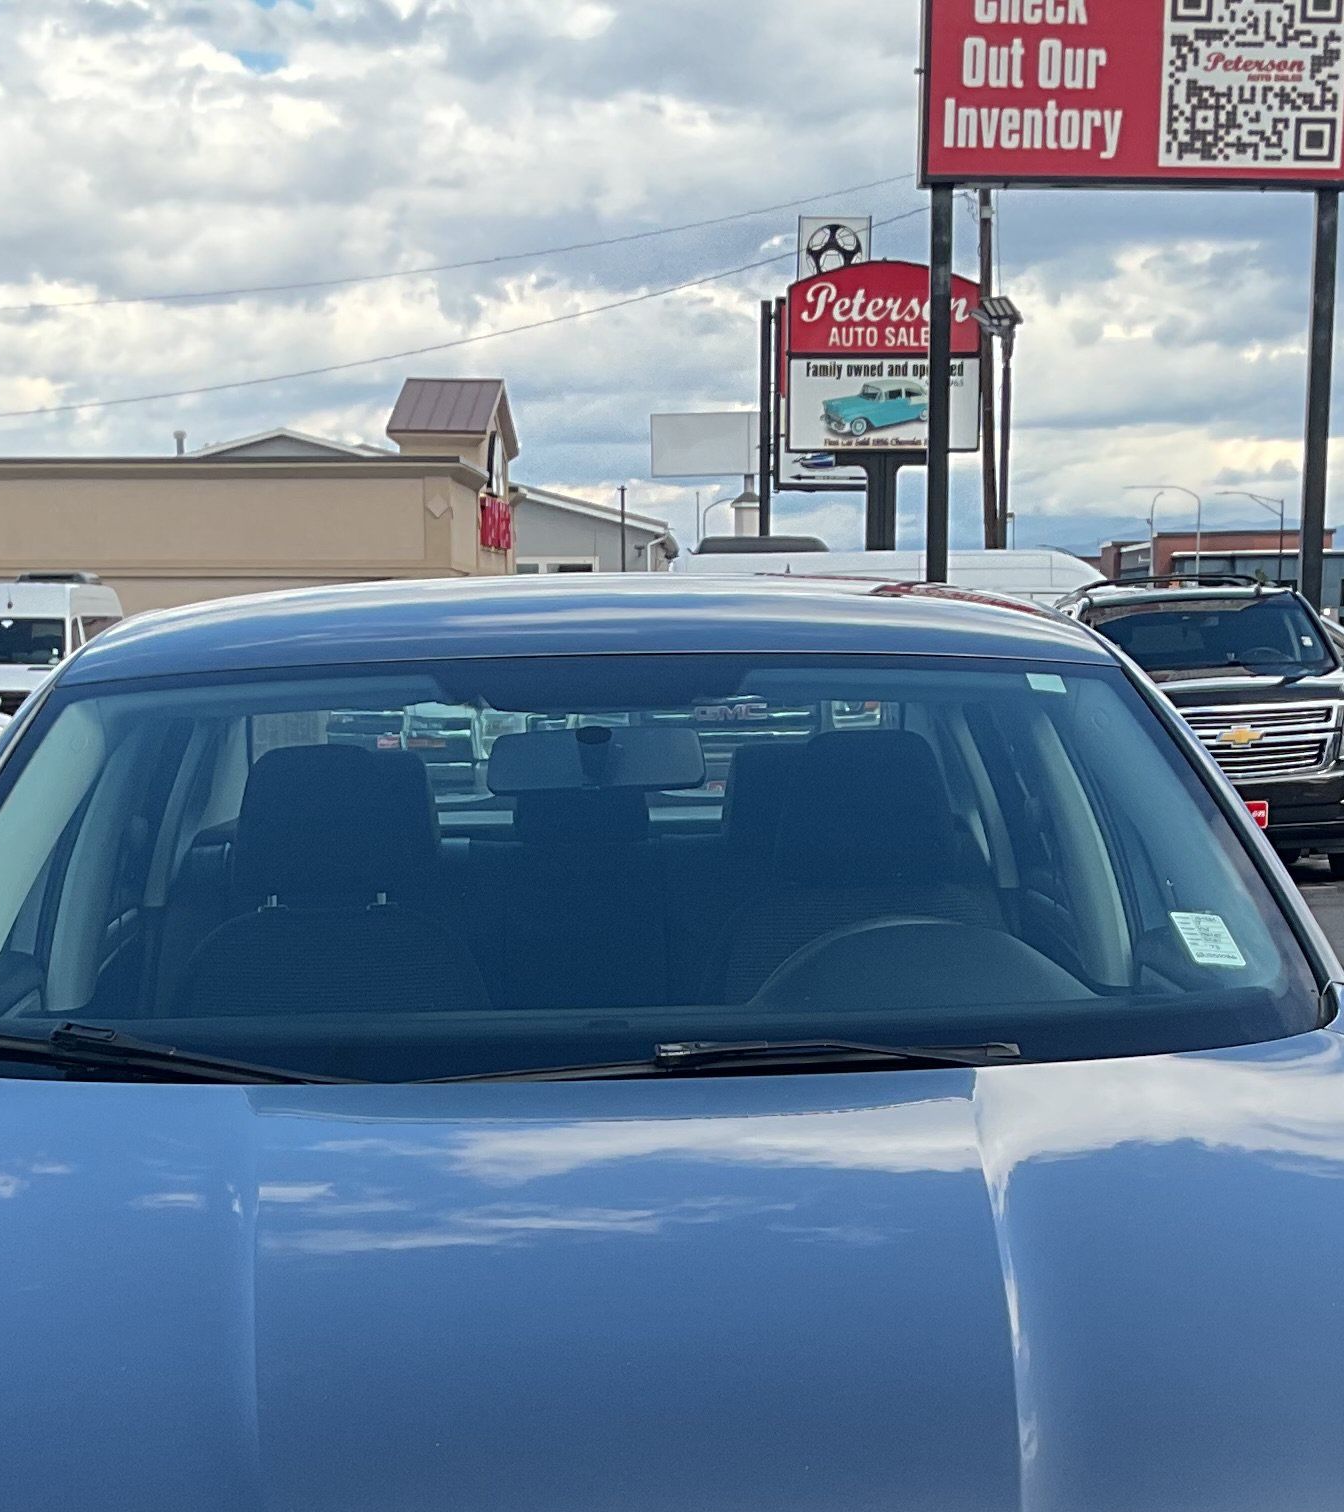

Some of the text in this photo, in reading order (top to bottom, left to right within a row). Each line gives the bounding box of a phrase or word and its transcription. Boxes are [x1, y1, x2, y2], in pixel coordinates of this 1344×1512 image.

[962, 36, 1107, 89] Out Our
[1203, 52, 1305, 72] Peterson
[943, 97, 1123, 159] Inventory
[800, 281, 970, 323] Petersn
[828, 326, 929, 347] AUTO SALE
[806, 361, 843, 380] Family
[846, 361, 883, 377] owned
[887, 361, 908, 377] and
[695, 702, 768, 721] GMC
